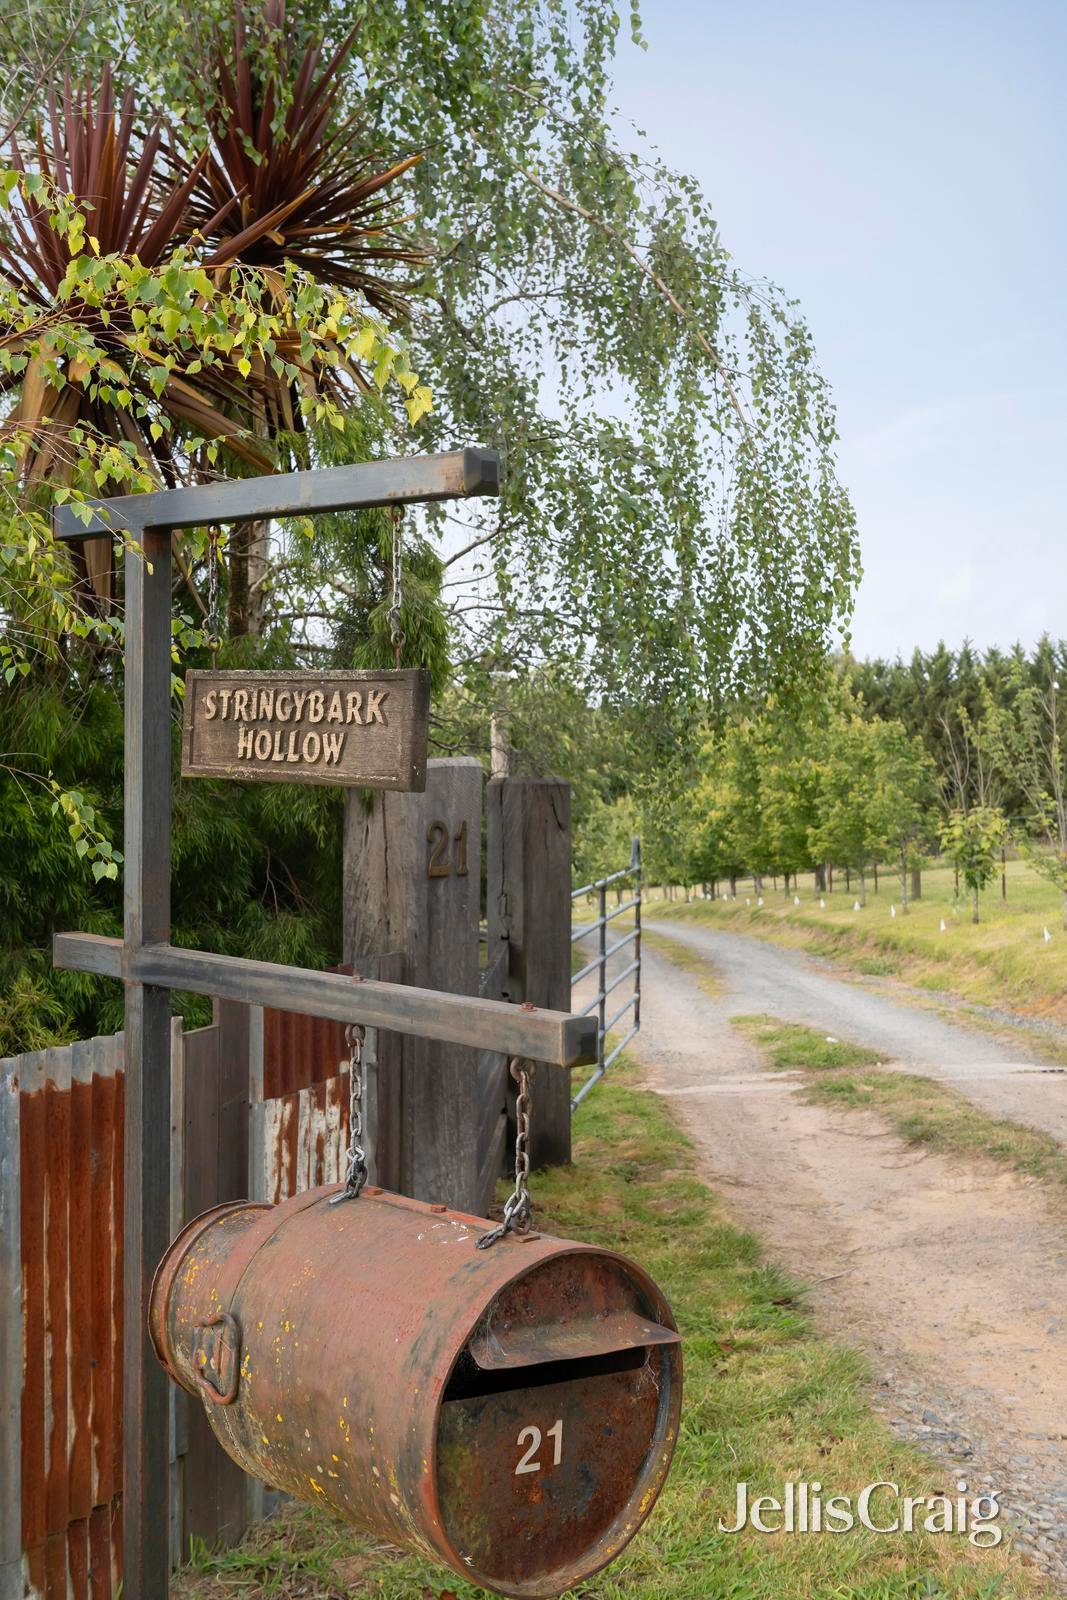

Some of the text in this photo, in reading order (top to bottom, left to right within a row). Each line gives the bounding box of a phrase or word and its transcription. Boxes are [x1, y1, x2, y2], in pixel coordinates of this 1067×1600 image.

[203, 689, 389, 725] STRINGYBARK
[238, 727, 345, 765] HOLLOW
[426, 820, 468, 879] 21
[515, 1419, 563, 1475] 21
